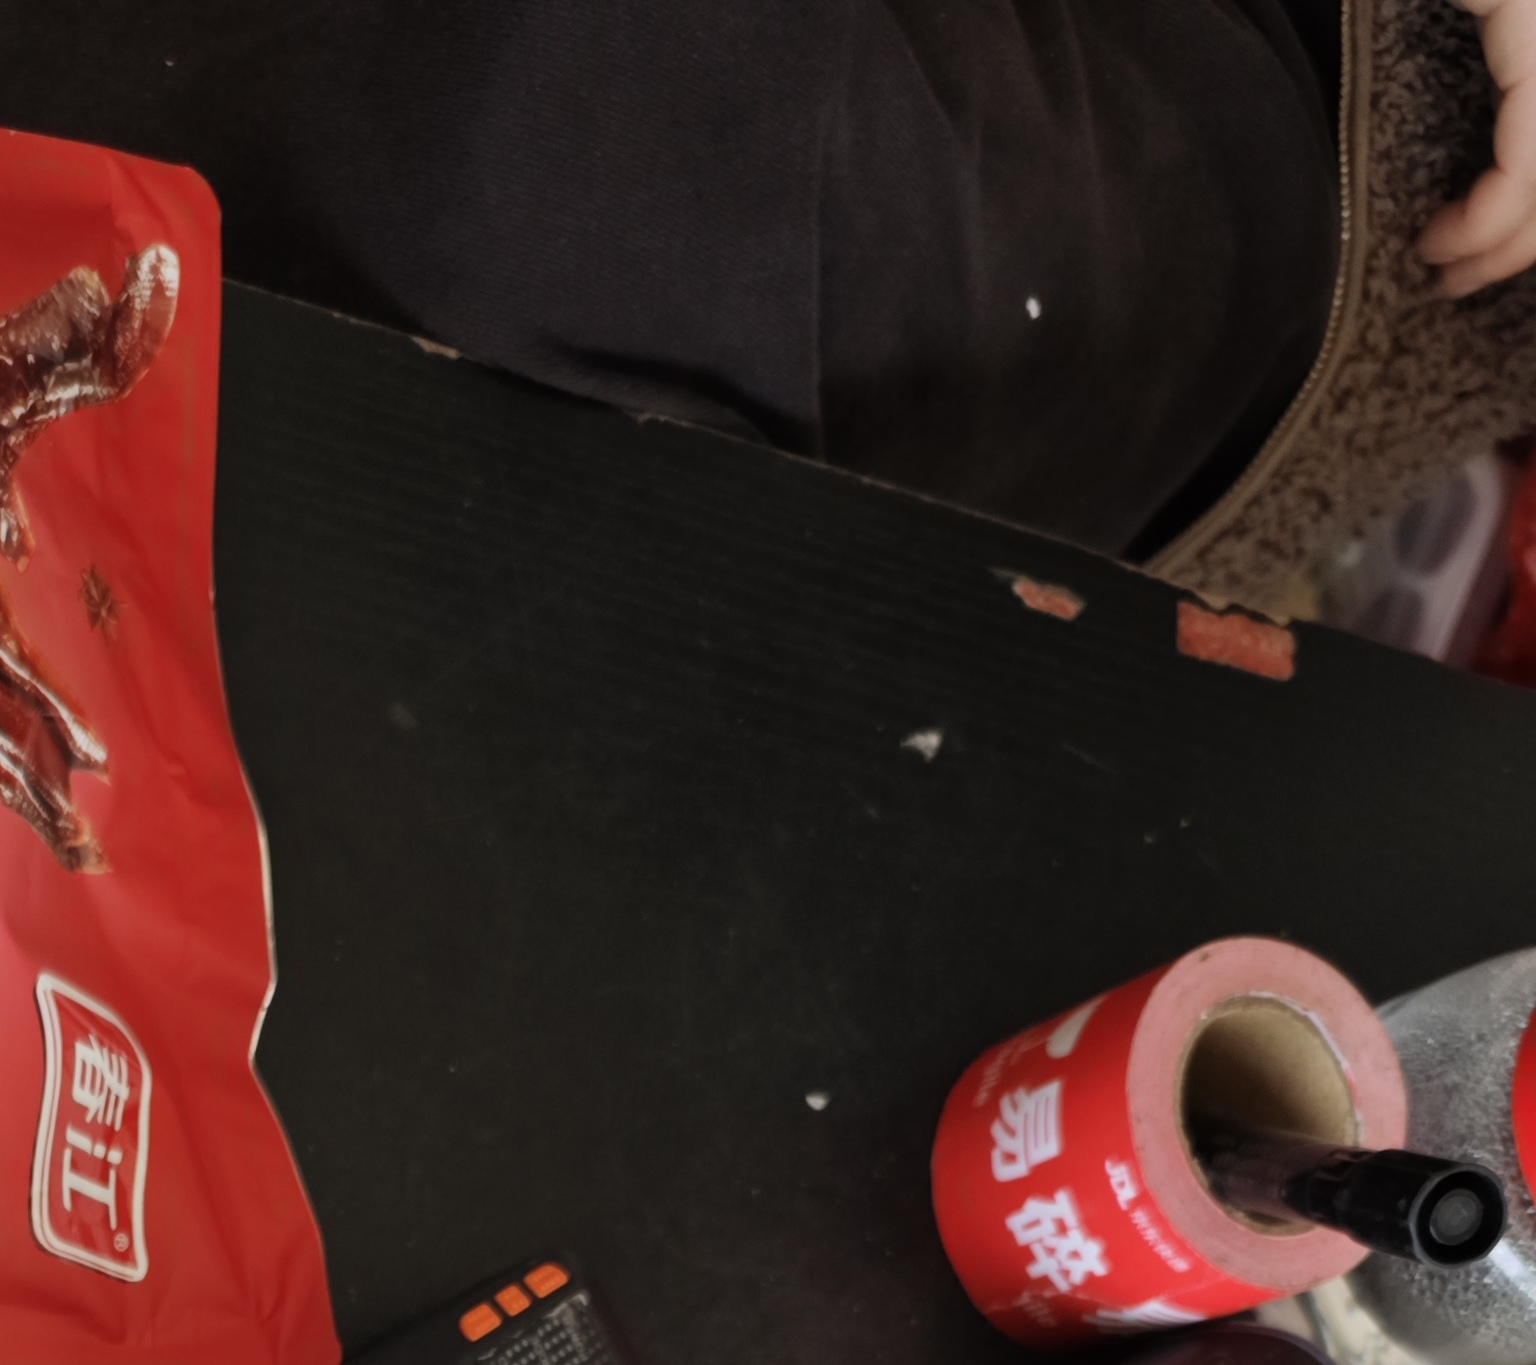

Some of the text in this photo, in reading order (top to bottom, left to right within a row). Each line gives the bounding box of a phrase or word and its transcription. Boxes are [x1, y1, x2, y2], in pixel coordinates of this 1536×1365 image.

[62, 1035, 129, 1231] 春江
[990, 1079, 1110, 1293] 易碎
[1105, 1158, 1139, 1210] JDL
